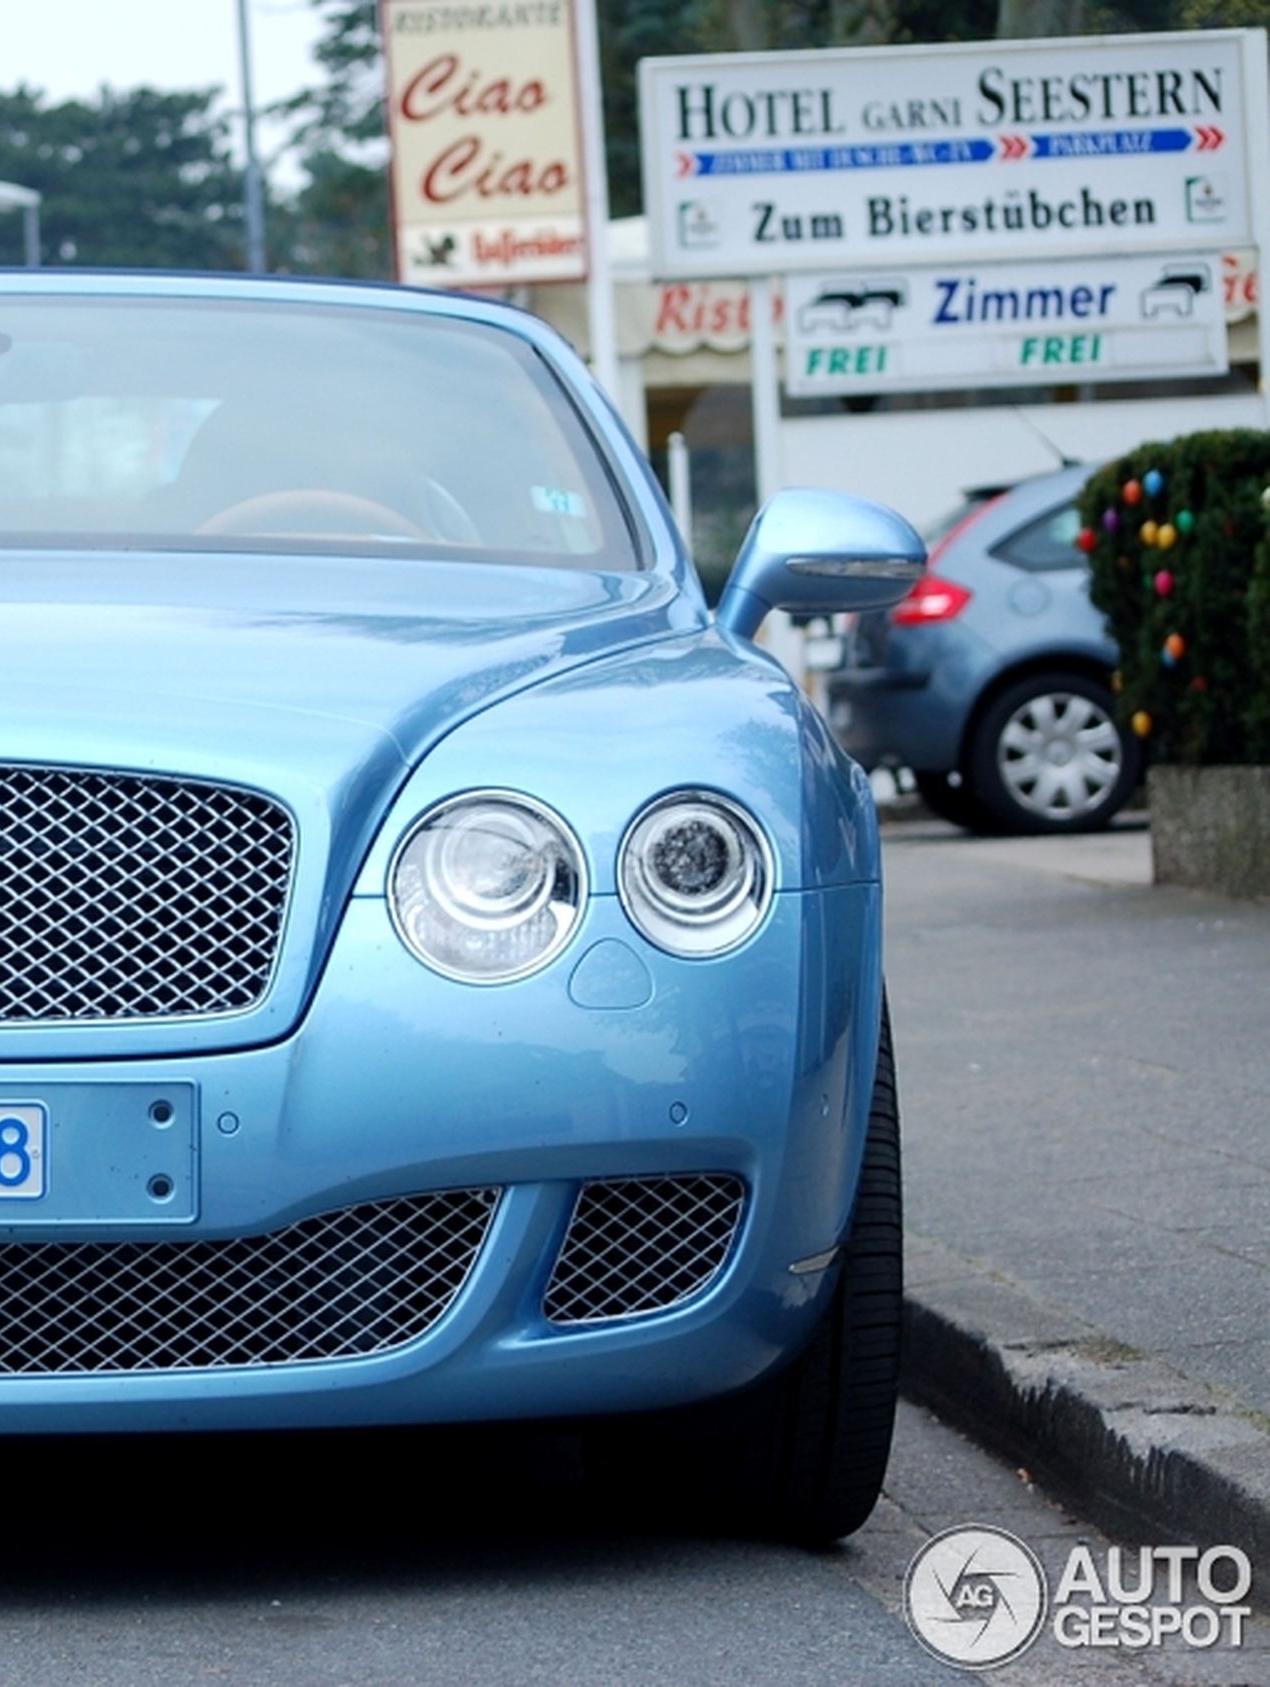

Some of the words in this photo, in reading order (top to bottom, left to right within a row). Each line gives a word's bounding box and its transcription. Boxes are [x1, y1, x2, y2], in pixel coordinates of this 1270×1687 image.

[400, 52, 548, 122] Ciao
[676, 84, 846, 140] HOTEL
[861, 98, 964, 131] GARNI
[977, 66, 1224, 127] SEESTERN
[422, 134, 569, 203] Ciao
[753, 203, 844, 242] Zum
[867, 187, 1156, 238] Bierstübchen
[932, 278, 1116, 325] Zimmer
[806, 347, 887, 376] FREI
[1020, 335, 1101, 366] FREI
